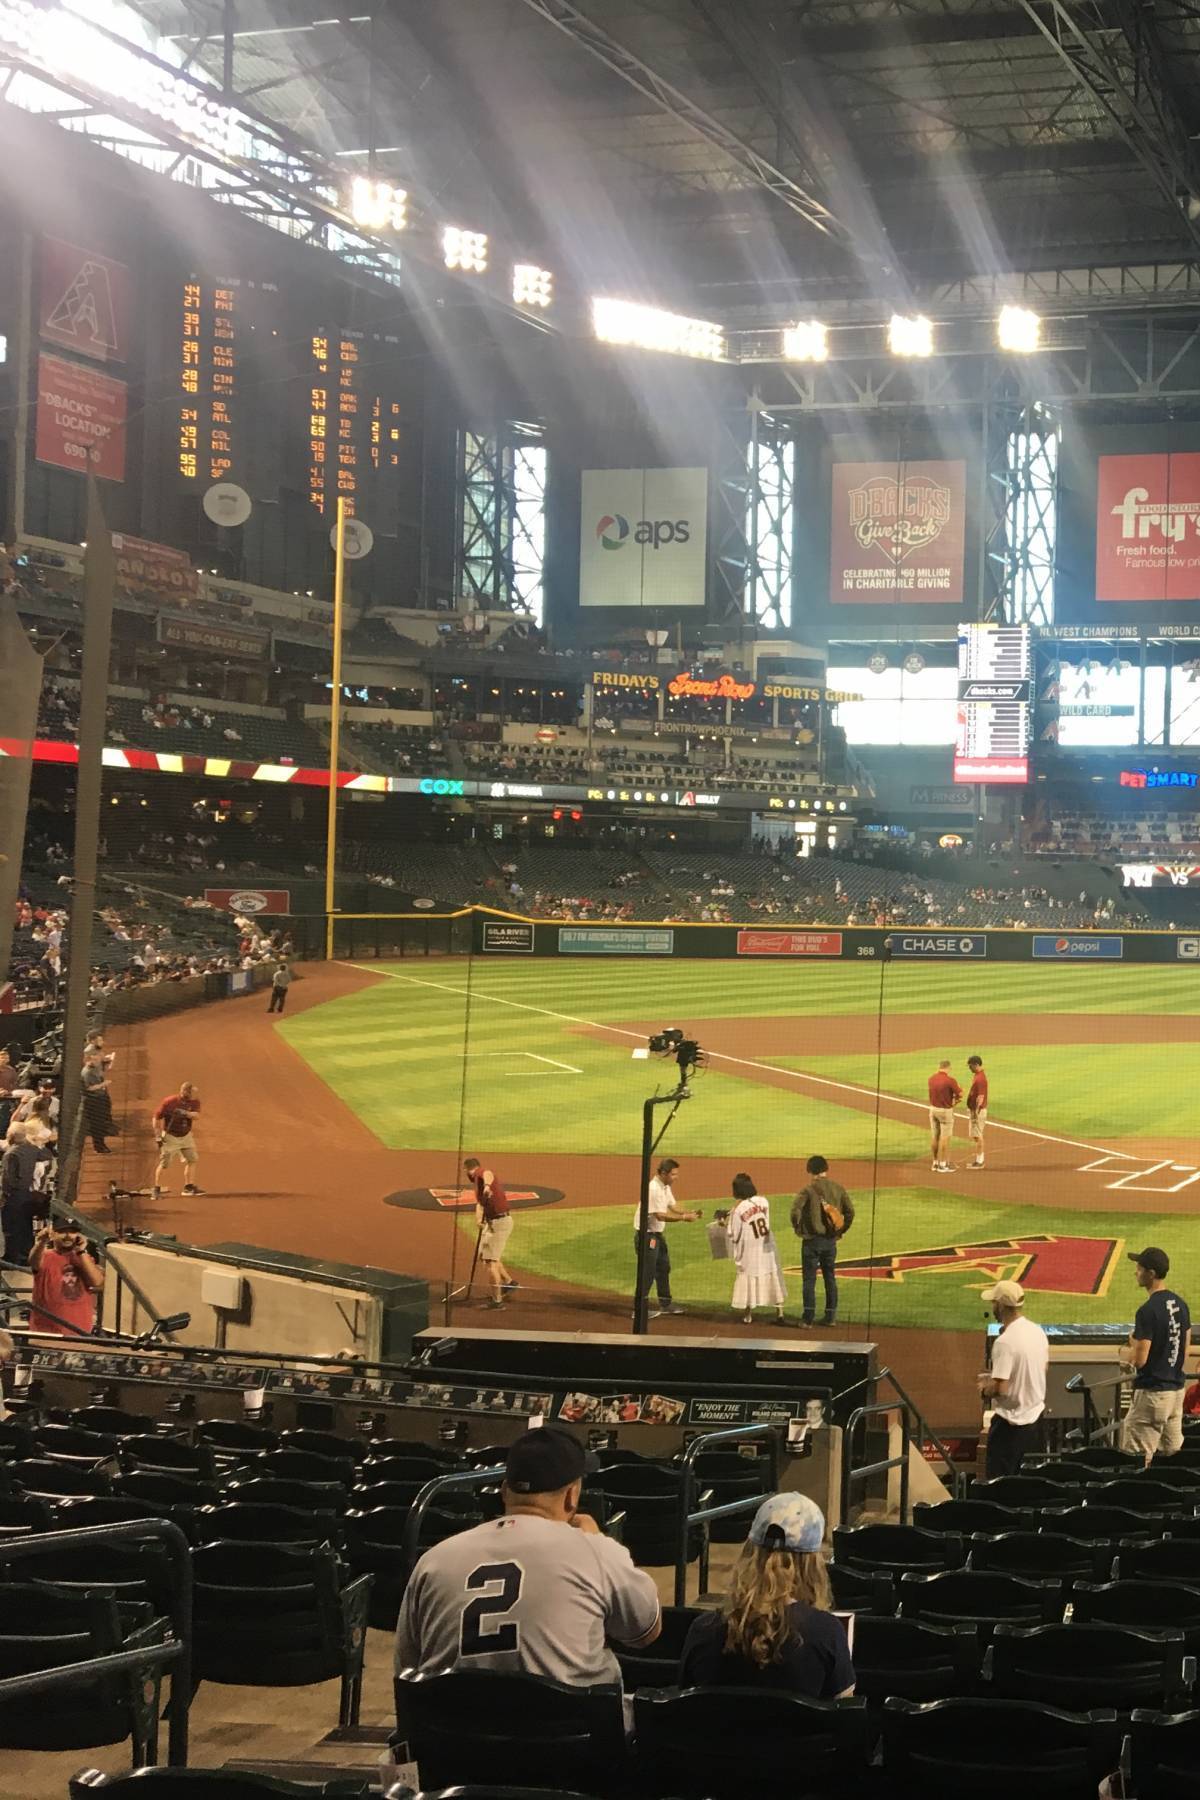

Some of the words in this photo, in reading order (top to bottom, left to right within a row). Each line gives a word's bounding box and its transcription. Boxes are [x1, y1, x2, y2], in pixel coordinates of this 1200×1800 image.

[184, 285, 200, 296] 44
[184, 296, 199, 308] 27
[184, 312, 199, 324] 39
[184, 324, 199, 336] 31
[312, 337, 327, 348] 54
[183, 353, 198, 364] 31
[312, 349, 327, 359] 46
[311, 389, 326, 400] 57
[311, 400, 326, 410] 44
[180, 437, 196, 448] 57
[180, 453, 196, 465] 95
[180, 466, 196, 477] 40
[634, 520, 690, 549] aps
[1116, 545, 1147, 555] Fresh
[1149, 544, 1177, 555] food.
[1125, 558, 1166, 568] Famous
[1168, 557, 1185, 566] low
[843, 568, 897, 578] CELEBRATING
[917, 568, 951, 578] MILLION
[843, 579, 853, 589] IN
[917, 578, 951, 589] GIVING
[1055, 627, 1079, 637] WEST
[1082, 626, 1139, 637] CHAMPIONS
[1159, 626, 1190, 636] WORLD
[593, 671, 659, 689] FRIDAY'S
[764, 684, 820, 701] SPORTS
[1060, 705, 1083, 716] WILD
[1086, 705, 1112, 716] CARD
[1120, 770, 1198, 789] PETSMART
[420, 778, 464, 795] COX
[1170, 872, 1189, 886] VS
[902, 938, 957, 951] CHASE
[1070, 941, 1100, 955] pepsi
[857, 946, 875, 956] 368
[749, 1217, 770, 1239] 18
[724, 1404, 741, 1412] THE
[459, 1561, 526, 1658] 2
